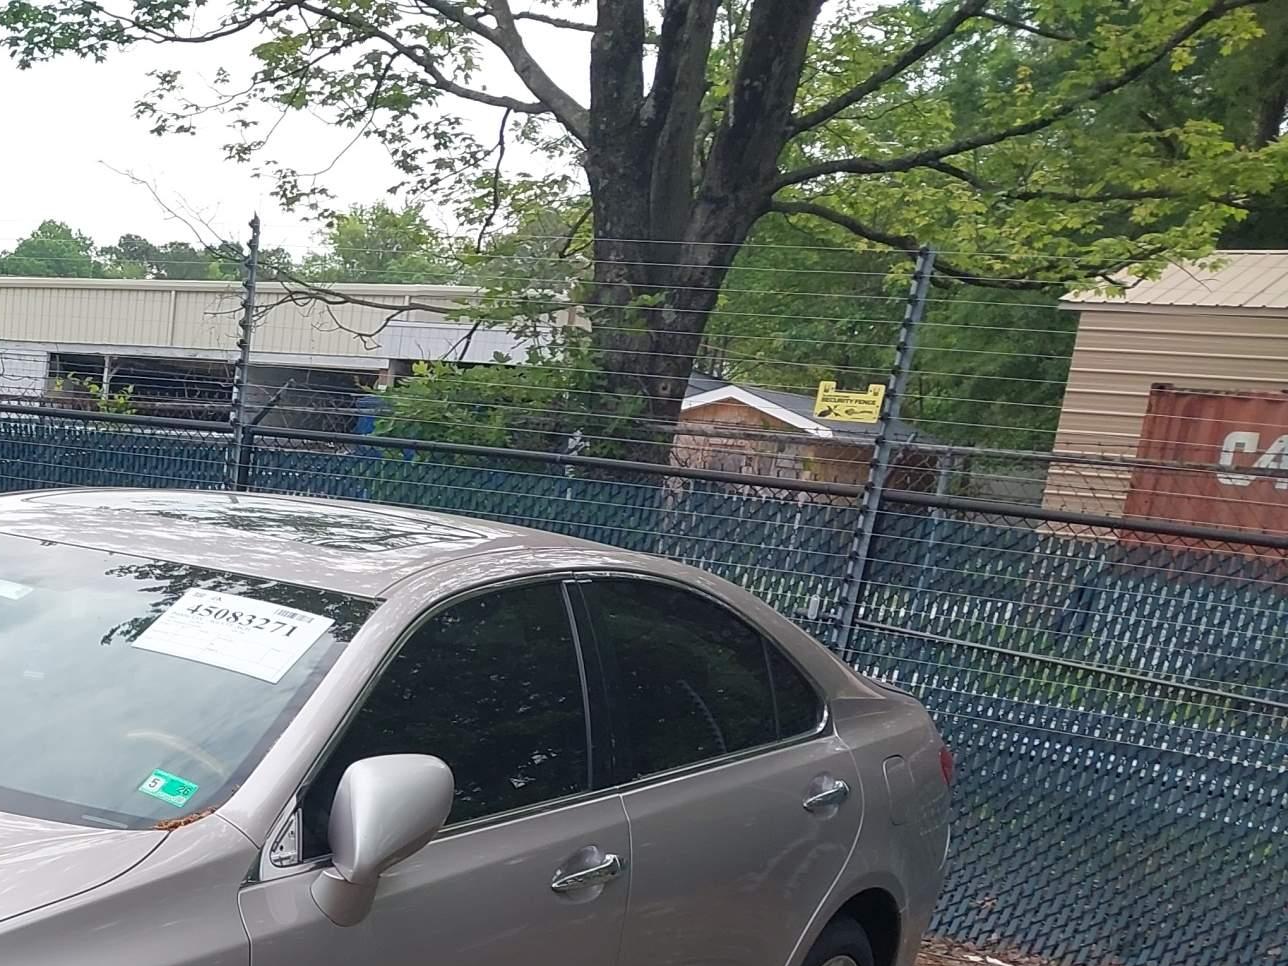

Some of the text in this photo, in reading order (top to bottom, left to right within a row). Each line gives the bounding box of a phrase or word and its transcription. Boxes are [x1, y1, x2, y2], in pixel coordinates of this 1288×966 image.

[187, 604, 298, 638] 45083271
[148, 778, 160, 788] 5
[176, 785, 193, 796] 26
